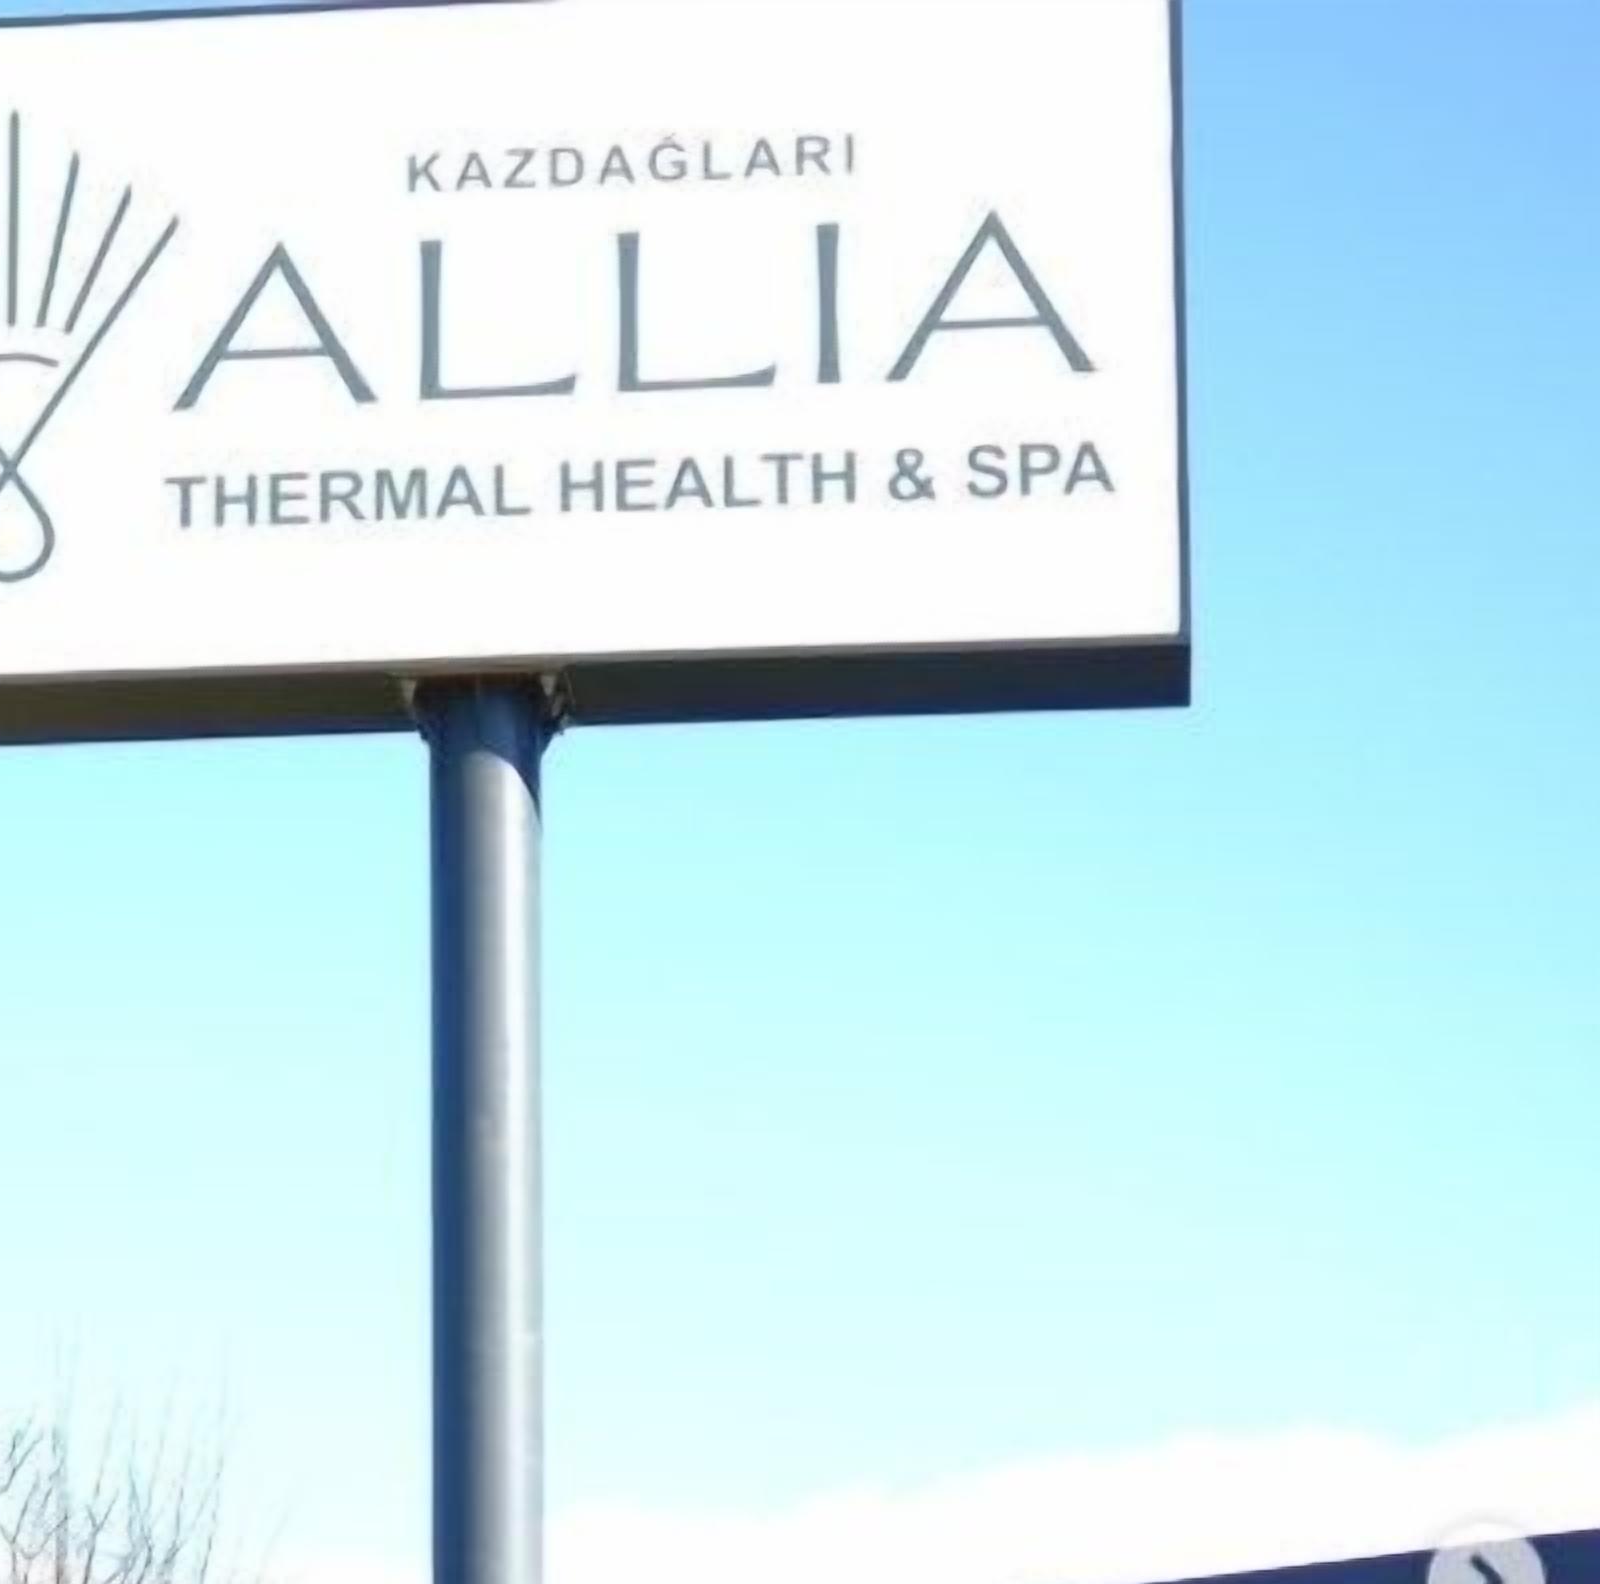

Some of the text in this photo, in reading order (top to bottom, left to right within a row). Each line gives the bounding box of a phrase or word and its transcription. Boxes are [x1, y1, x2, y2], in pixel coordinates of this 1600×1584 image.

[406, 132, 859, 195] KAZDAĞLARI
[170, 209, 1098, 413] ALLIA
[164, 440, 1116, 531] THERMAL HEALTH & SPA
